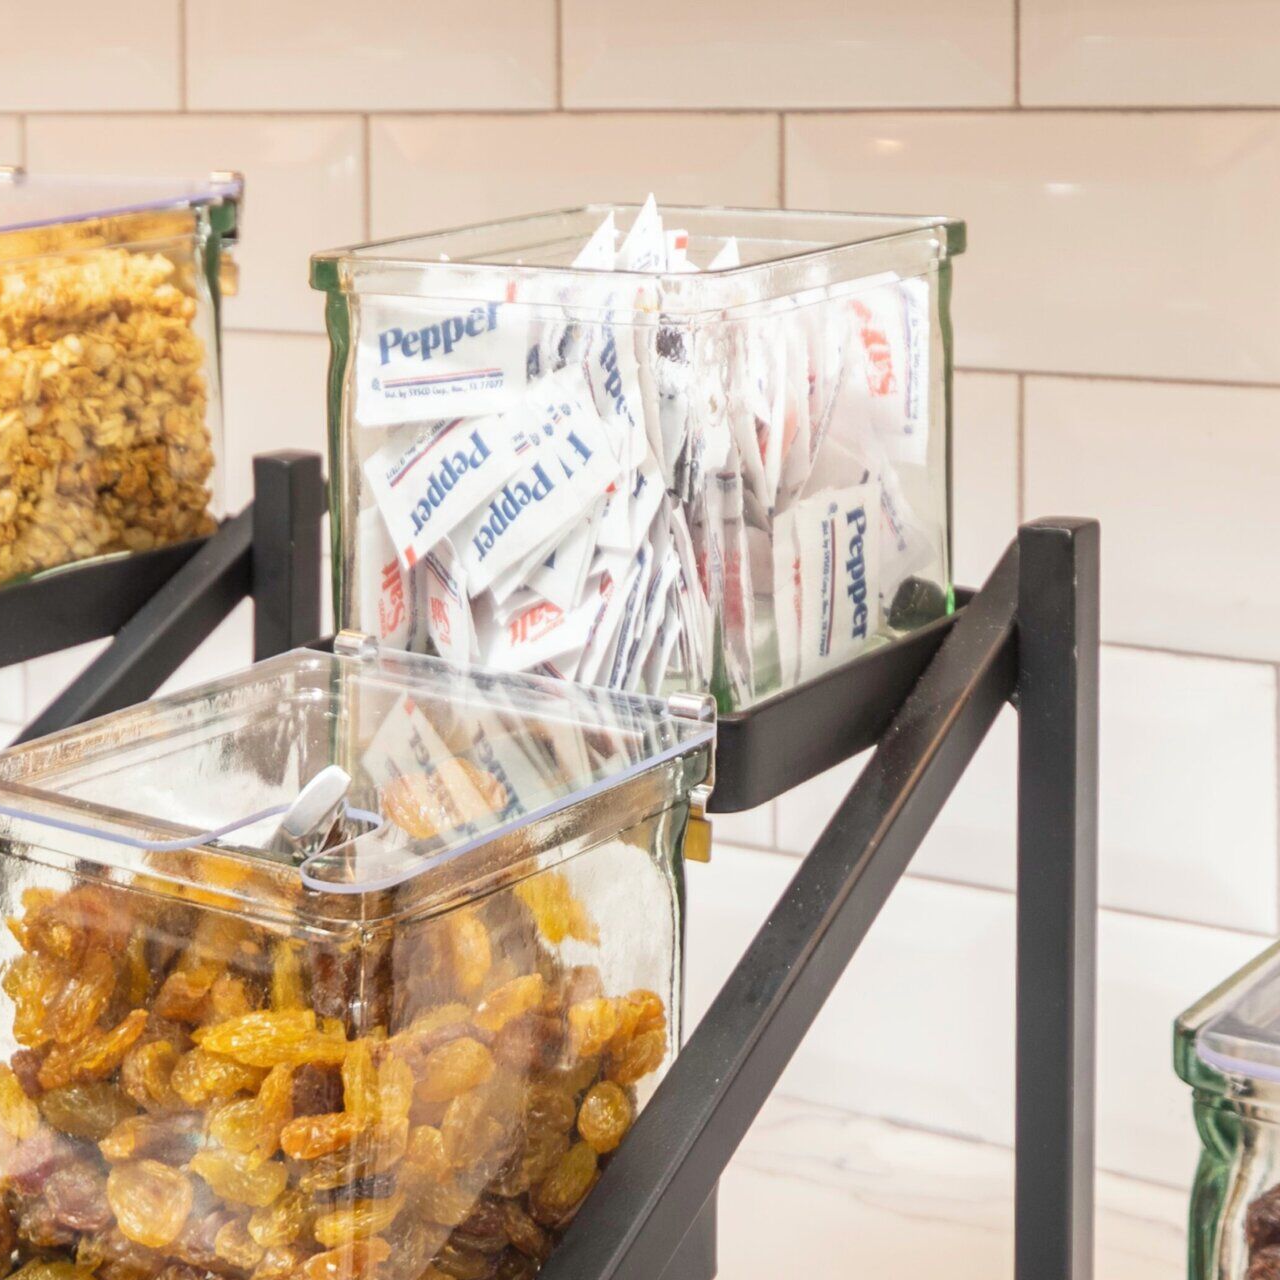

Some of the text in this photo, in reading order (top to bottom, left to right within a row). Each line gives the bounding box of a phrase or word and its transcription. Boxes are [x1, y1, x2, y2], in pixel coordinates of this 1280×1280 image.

[378, 301, 504, 365] Pepper
[410, 428, 492, 537] Pepper
[472, 460, 555, 562] Pepper
[846, 503, 869, 640] Pepper
